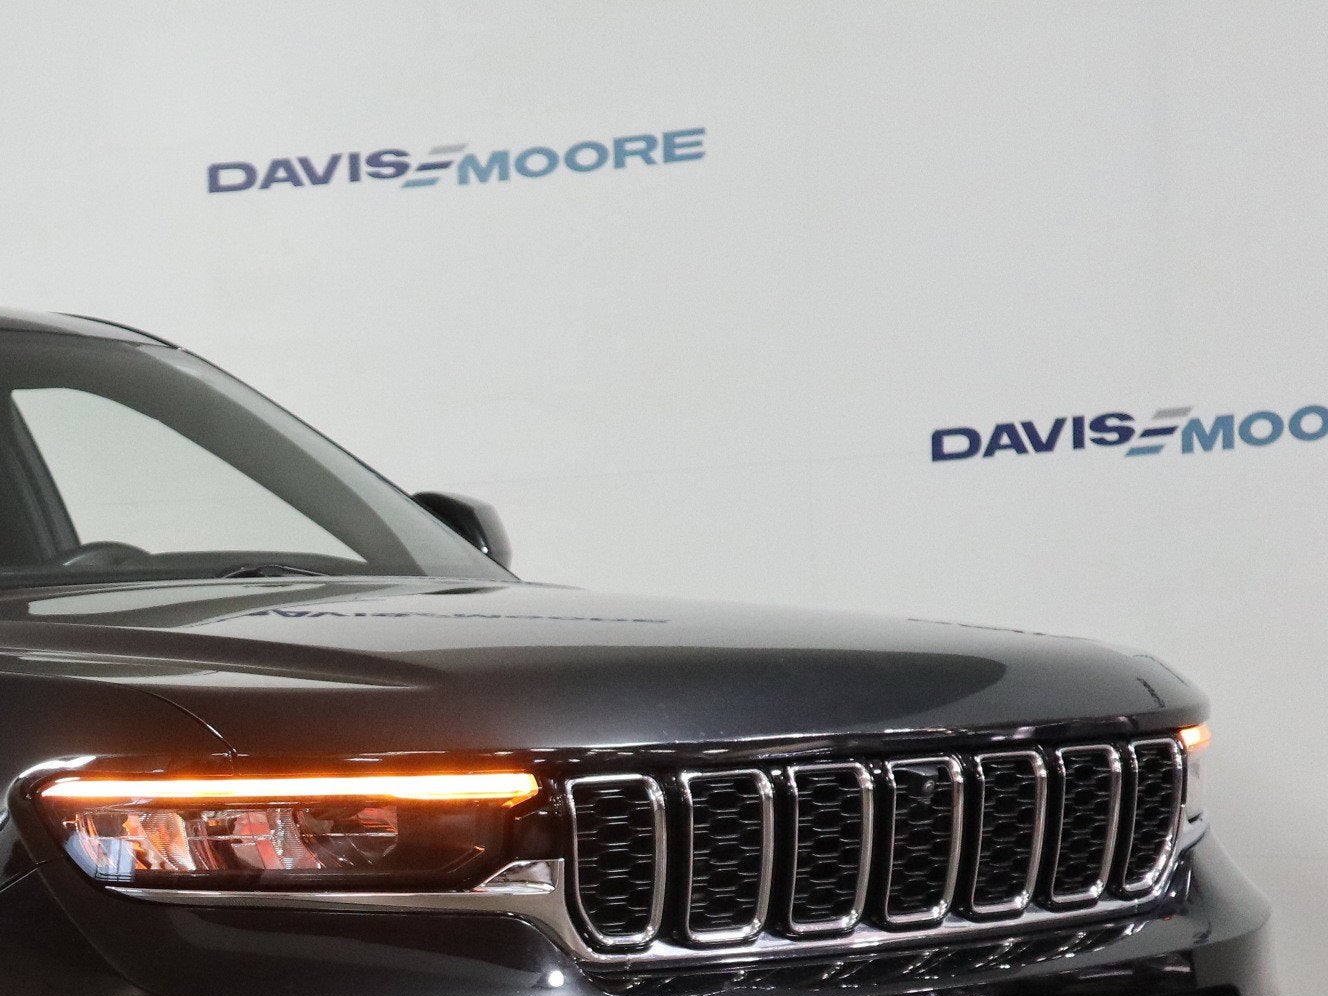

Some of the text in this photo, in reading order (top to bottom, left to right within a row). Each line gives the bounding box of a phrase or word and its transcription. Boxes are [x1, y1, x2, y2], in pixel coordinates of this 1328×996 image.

[206, 126, 707, 195] DAVIS MOORE
[929, 410, 1137, 464] DAVIS
